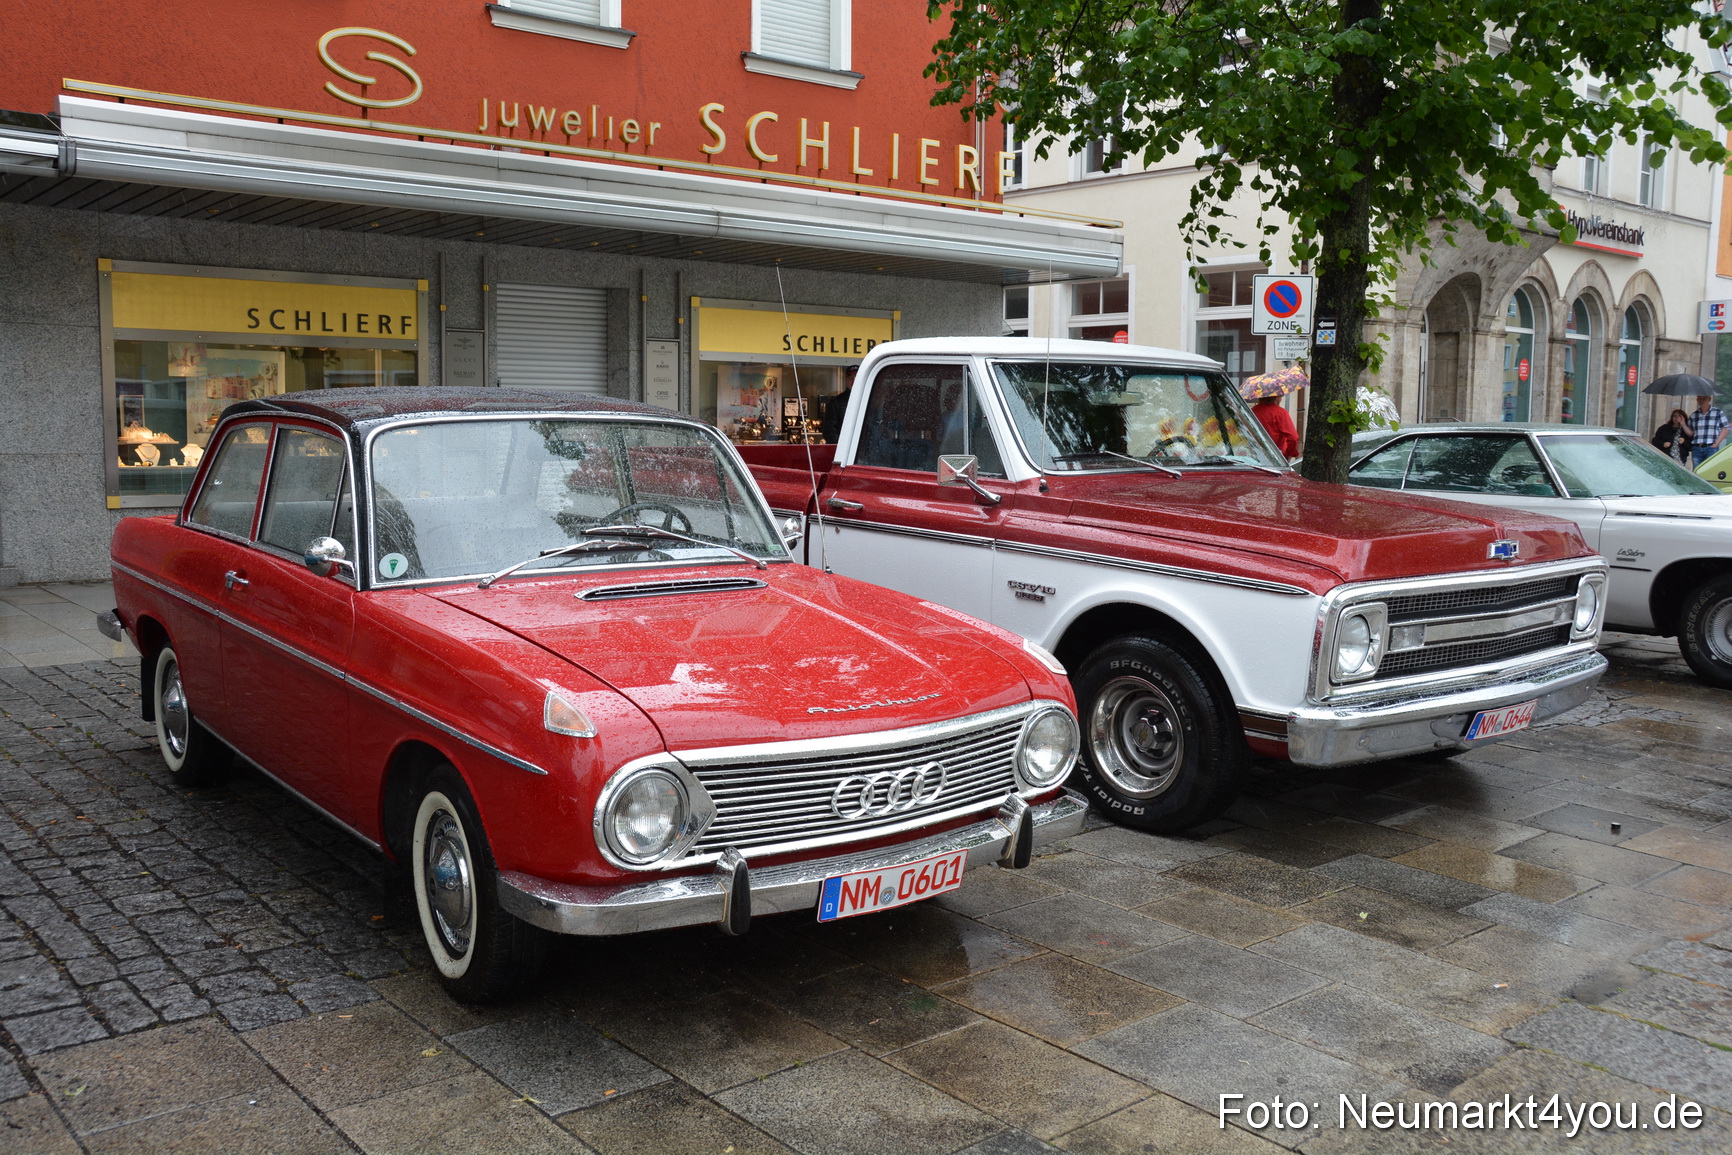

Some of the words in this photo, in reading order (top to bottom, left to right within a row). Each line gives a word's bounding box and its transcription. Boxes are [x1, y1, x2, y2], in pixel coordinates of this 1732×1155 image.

[699, 102, 1016, 195] SCHLIERF
[1567, 209, 1645, 247] HypoVereinsbank
[247, 307, 412, 336] SCHLIERF
[1267, 320, 1297, 331] ZONE
[782, 333, 891, 355] SCHLIER
[1686, 589, 1716, 652] GENERAL
[1476, 713, 1501, 736] NM
[1502, 703, 1535, 731] 0644
[1092, 785, 1146, 817] Radial
[825, 902, 833, 913] D
[839, 865, 883, 913] NM
[898, 855, 962, 900] 0601
